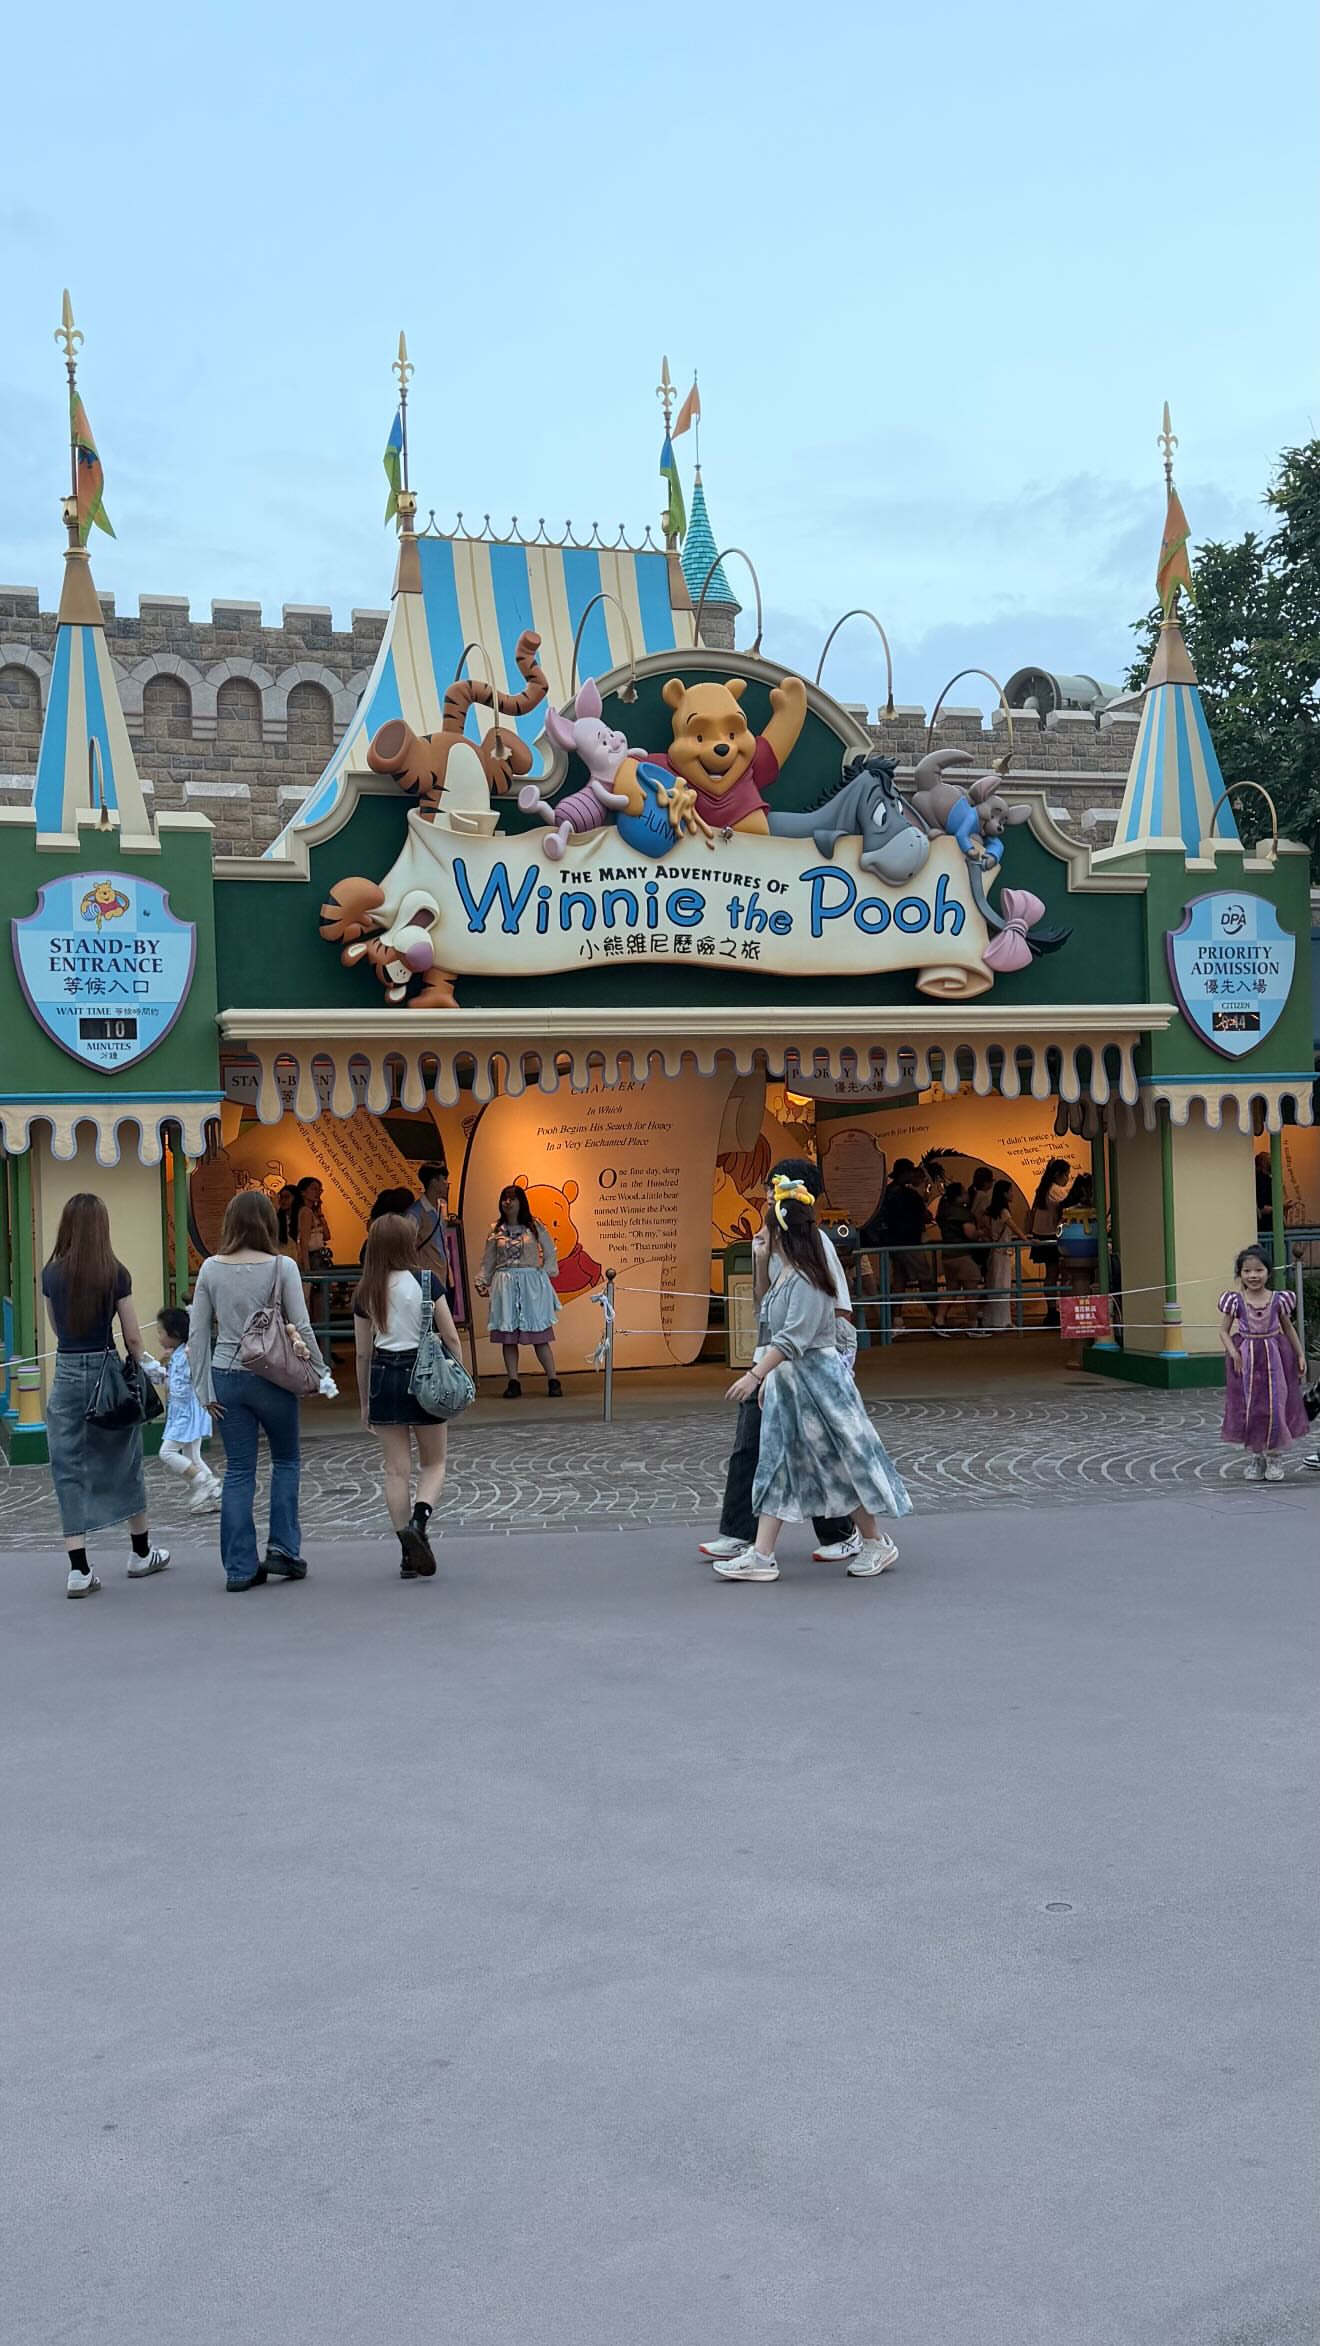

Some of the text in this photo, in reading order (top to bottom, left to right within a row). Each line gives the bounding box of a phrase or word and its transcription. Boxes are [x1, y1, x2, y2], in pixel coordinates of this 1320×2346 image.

[560, 865, 790, 895] THE MANY ADVENTURES OF
[452, 857, 966, 938] Winnie the Pooh
[1221, 913, 1247, 925] DPA
[49, 937, 161, 955] STAND-BY
[579, 933, 761, 960] 小熊維尼歷險之旅
[1198, 946, 1272, 960] PRIORITY
[48, 957, 163, 973] ENTRANCE
[1190, 962, 1280, 975] ADMISSION
[63, 976, 150, 995] 等候入口
[1203, 979, 1268, 994] 優先入場
[56, 1007, 83, 1016] WAIT
[87, 1007, 112, 1016] TIME
[104, 1020, 126, 1038] 10
[86, 1042, 132, 1051] MINUTES
[587, 1104, 623, 1115] In Which
[537, 1120, 673, 1136] Pooh Begins His Search for Honey
[546, 1141, 555, 1151] In
[564, 1140, 581, 1150] Very
[584, 1138, 627, 1148] Enchanted
[628, 1137, 649, 1146] Place
[662, 1167, 680, 1176] deep
[631, 1180, 643, 1188] the
[647, 1179, 679, 1188] Hundred
[599, 1193, 616, 1201] Acre
[663, 1191, 678, 1199] bear
[594, 1204, 678, 1215] named Winnie the Pooh
[596, 1219, 627, 1228] suddenly
[662, 1229, 677, 1237] said
[651, 1241, 677, 1251] rumbly
[620, 1256, 627, 1264] in
[633, 1255, 645, 1264] my
